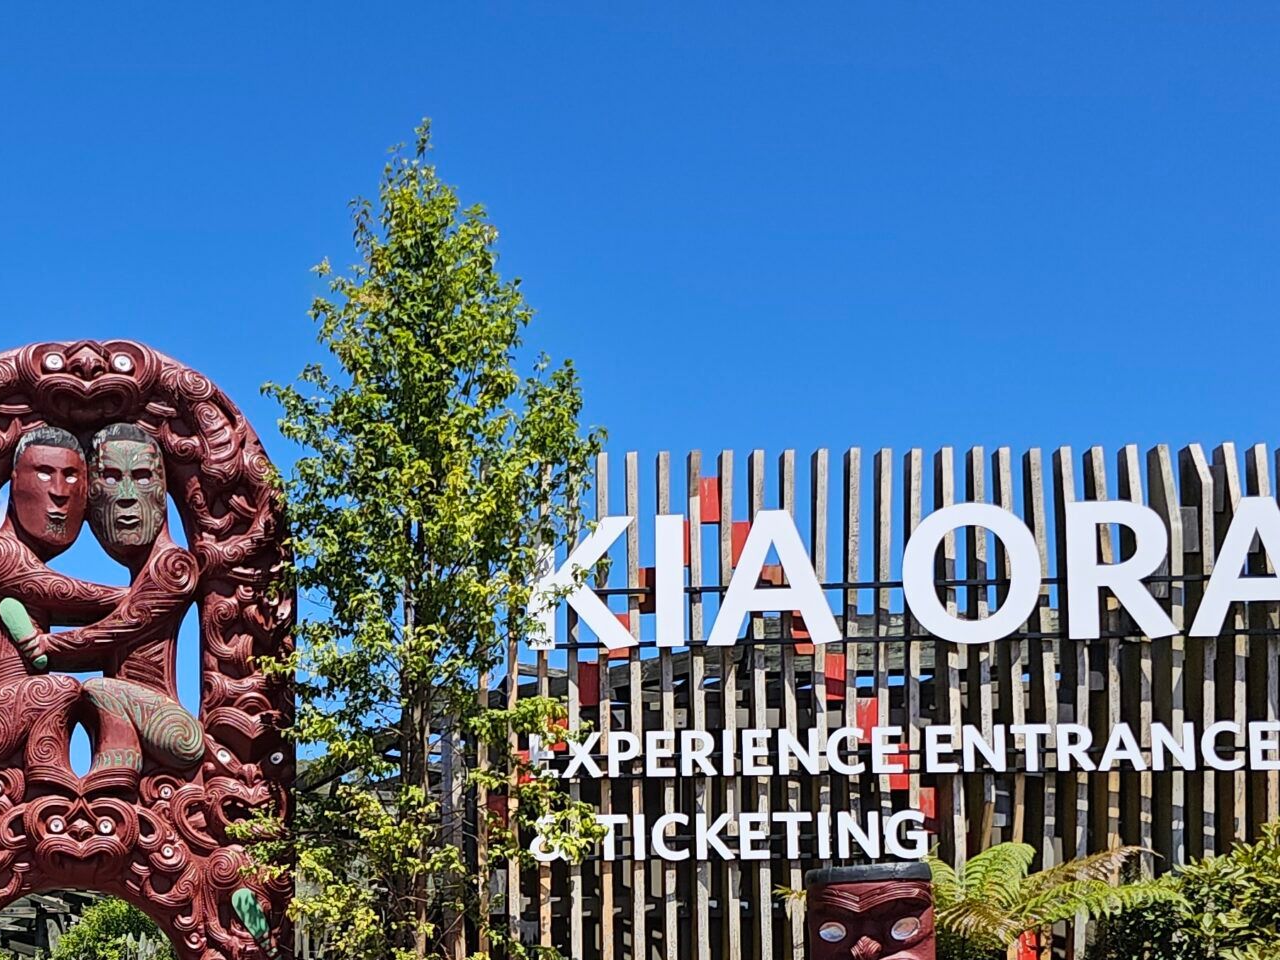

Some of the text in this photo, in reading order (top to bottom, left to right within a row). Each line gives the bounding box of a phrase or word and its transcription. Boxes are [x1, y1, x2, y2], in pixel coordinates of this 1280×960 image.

[527, 496, 1280, 650] KIA ORA
[529, 721, 1280, 779] EXPERIENCE ENTRANCE
[596, 810, 928, 861] TICKETING
